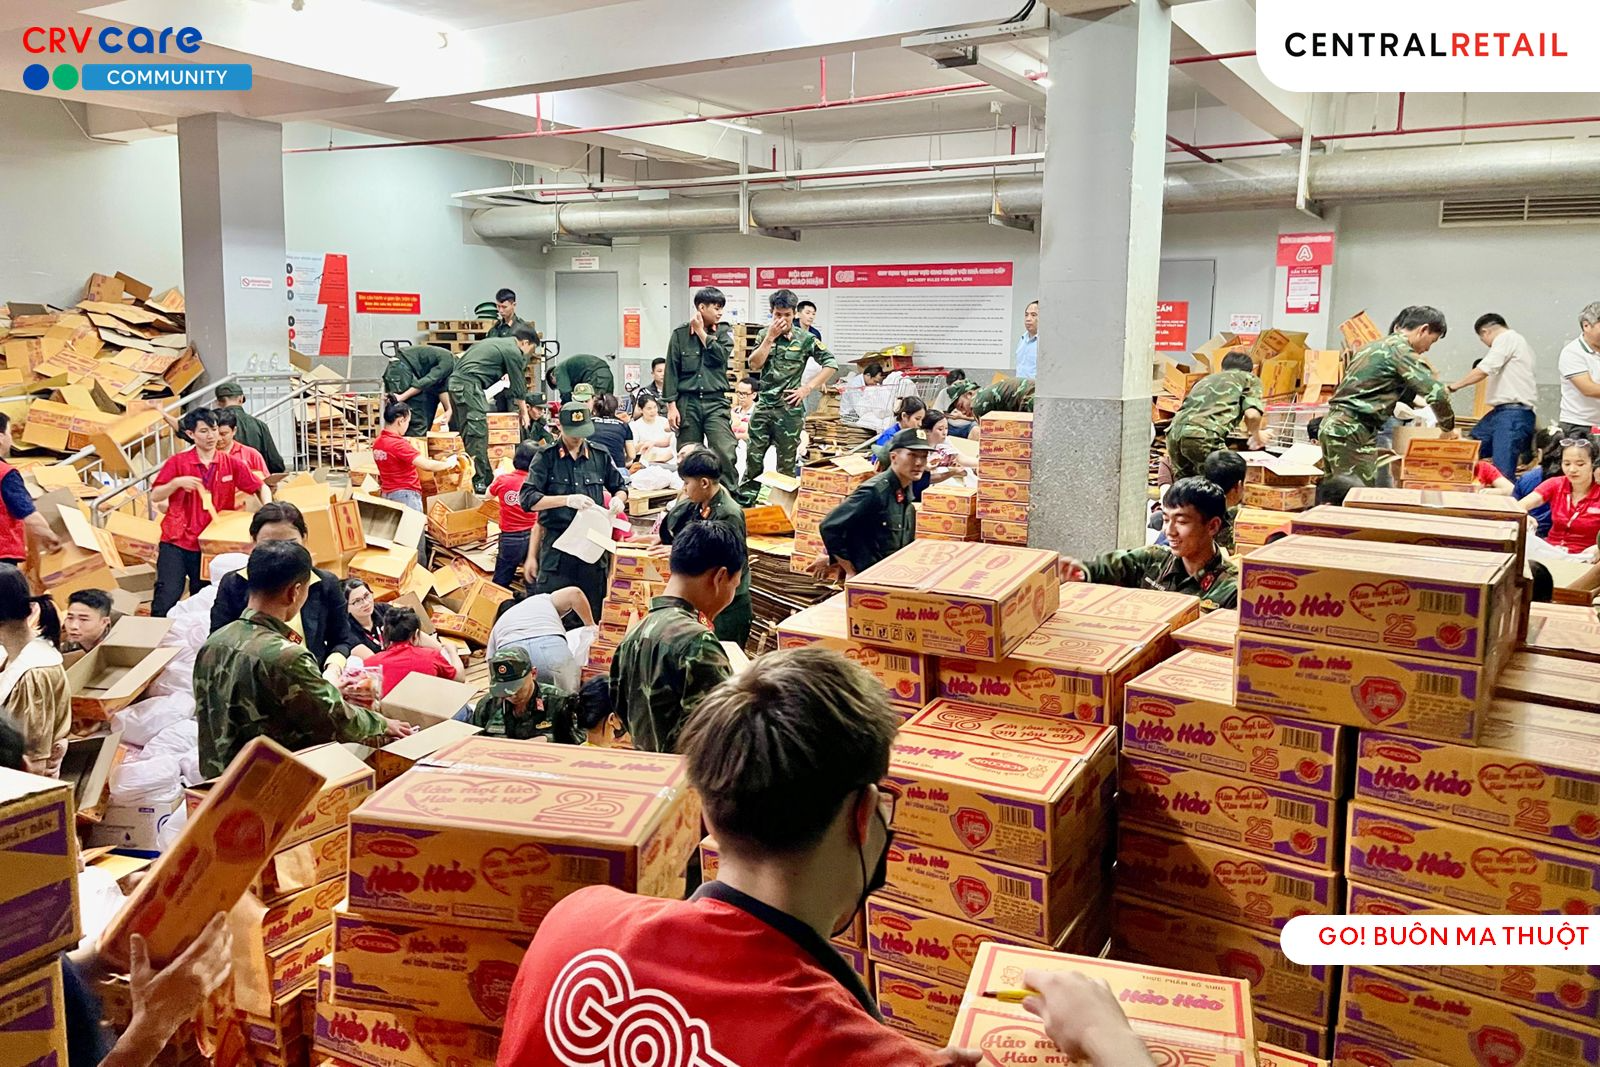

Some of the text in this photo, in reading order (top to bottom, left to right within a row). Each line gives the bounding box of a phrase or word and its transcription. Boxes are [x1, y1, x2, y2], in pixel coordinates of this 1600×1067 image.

[1296, 245, 1313, 262] A
[1255, 592, 1344, 617] Hảo Hảo
[1351, 591, 1369, 600] Hảo
[896, 607, 940, 621] Hảo Hảo
[1384, 613, 1417, 638] 25
[966, 629, 988, 649] 25
[1298, 655, 1352, 670] Hảo Hảo
[948, 675, 1011, 697] Hảo Hảo
[1039, 694, 1062, 714] 25
[931, 712, 994, 731] 25
[1047, 726, 1073, 735] Hảo
[1222, 722, 1238, 731] Hảo
[1052, 734, 1079, 742] Hảo
[1137, 719, 1216, 746] Hảo Hảo
[894, 744, 964, 760] Hảo Hảo
[1250, 746, 1280, 770] 25
[570, 759, 666, 773] Hảo Hảo
[972, 758, 1025, 771] ACECOOK
[411, 784, 453, 794] Hảo
[503, 782, 534, 794] lúc
[1374, 765, 1472, 797] Hảo Hảo
[419, 795, 460, 804] Hảo
[907, 787, 949, 802] Hảo Hảo
[1172, 791, 1211, 815] Hảo
[1217, 792, 1233, 801] Hảo
[538, 790, 630, 819] 25
[1515, 797, 1551, 824] 25
[1245, 816, 1274, 840] 25
[908, 853, 950, 870] Hảo Hảo
[1367, 845, 1465, 879] Hảo Hảo
[366, 860, 476, 893] Hảo Hảo
[1244, 891, 1274, 917] 25
[1507, 882, 1542, 909] 25
[267, 907, 313, 941] Hảo Hảo
[409, 935, 467, 954] Hảo Hảo
[881, 932, 950, 960] Hảo Hảo
[282, 947, 324, 981] Hảo Hảo
[1142, 975, 1162, 983] THỰC
[1164, 977, 1189, 986] PHẨM
[1205, 984, 1227, 992] SUNG
[928, 991, 949, 1004] Hảo
[1118, 988, 1225, 1012] Hảo Hảo
[330, 1011, 411, 1051] Hảo Hảo
[983, 1035, 1026, 1049] Hảo
[1000, 1053, 1037, 1064] Hảo
